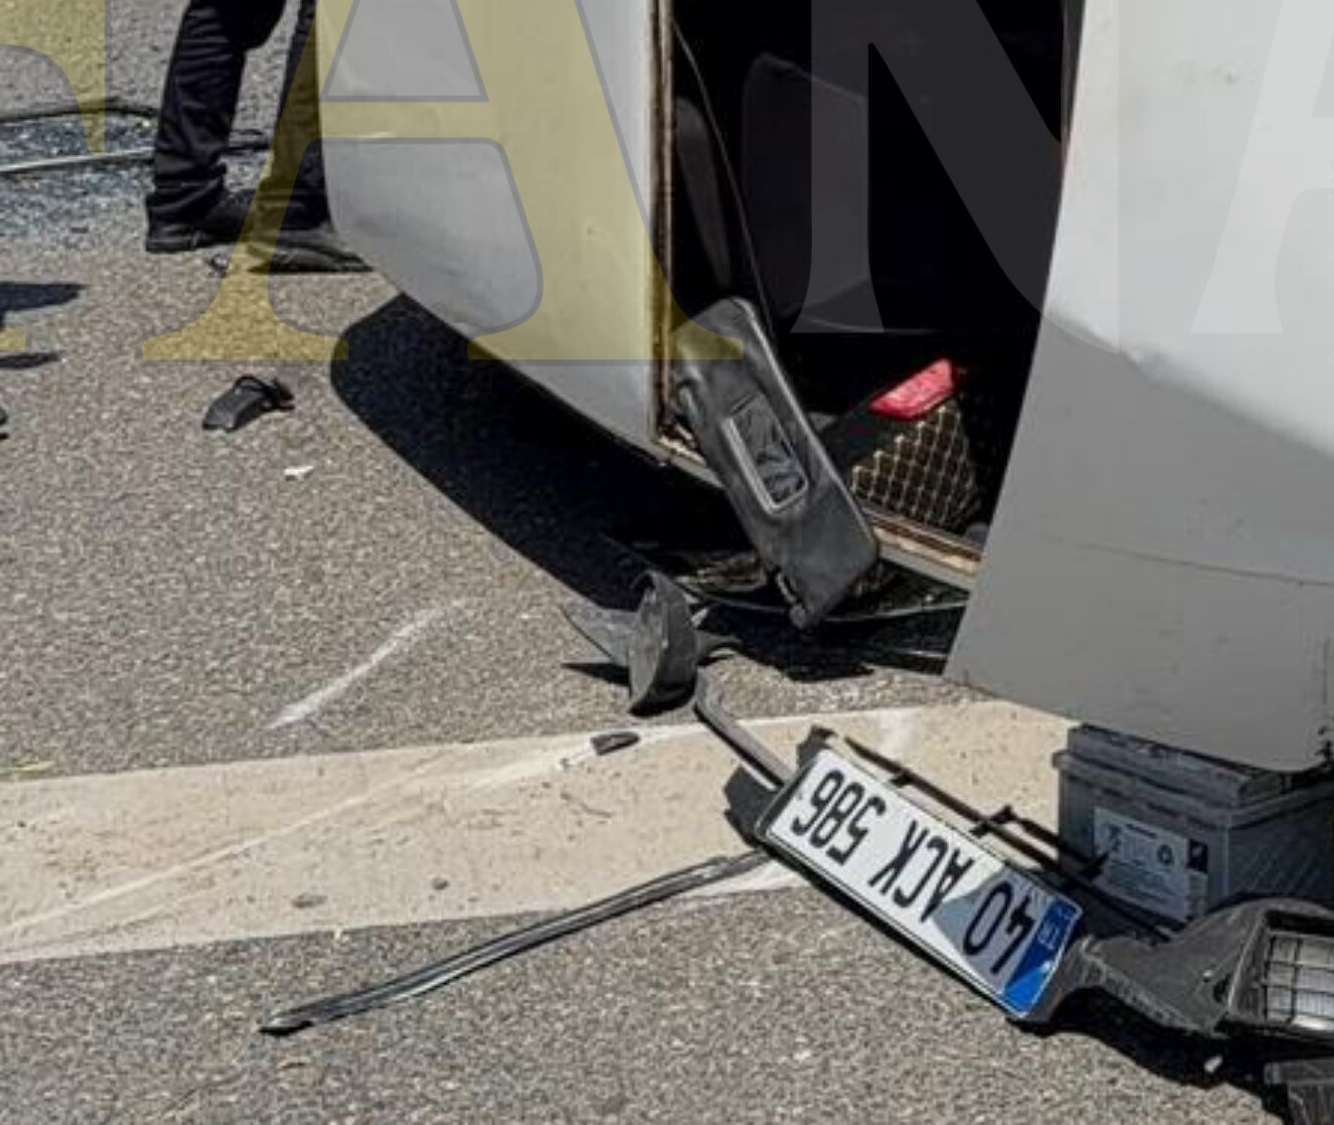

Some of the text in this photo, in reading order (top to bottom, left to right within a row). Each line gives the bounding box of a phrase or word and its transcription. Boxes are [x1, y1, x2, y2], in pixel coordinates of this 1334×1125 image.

[790, 769, 1035, 974] 40 ACK 586
